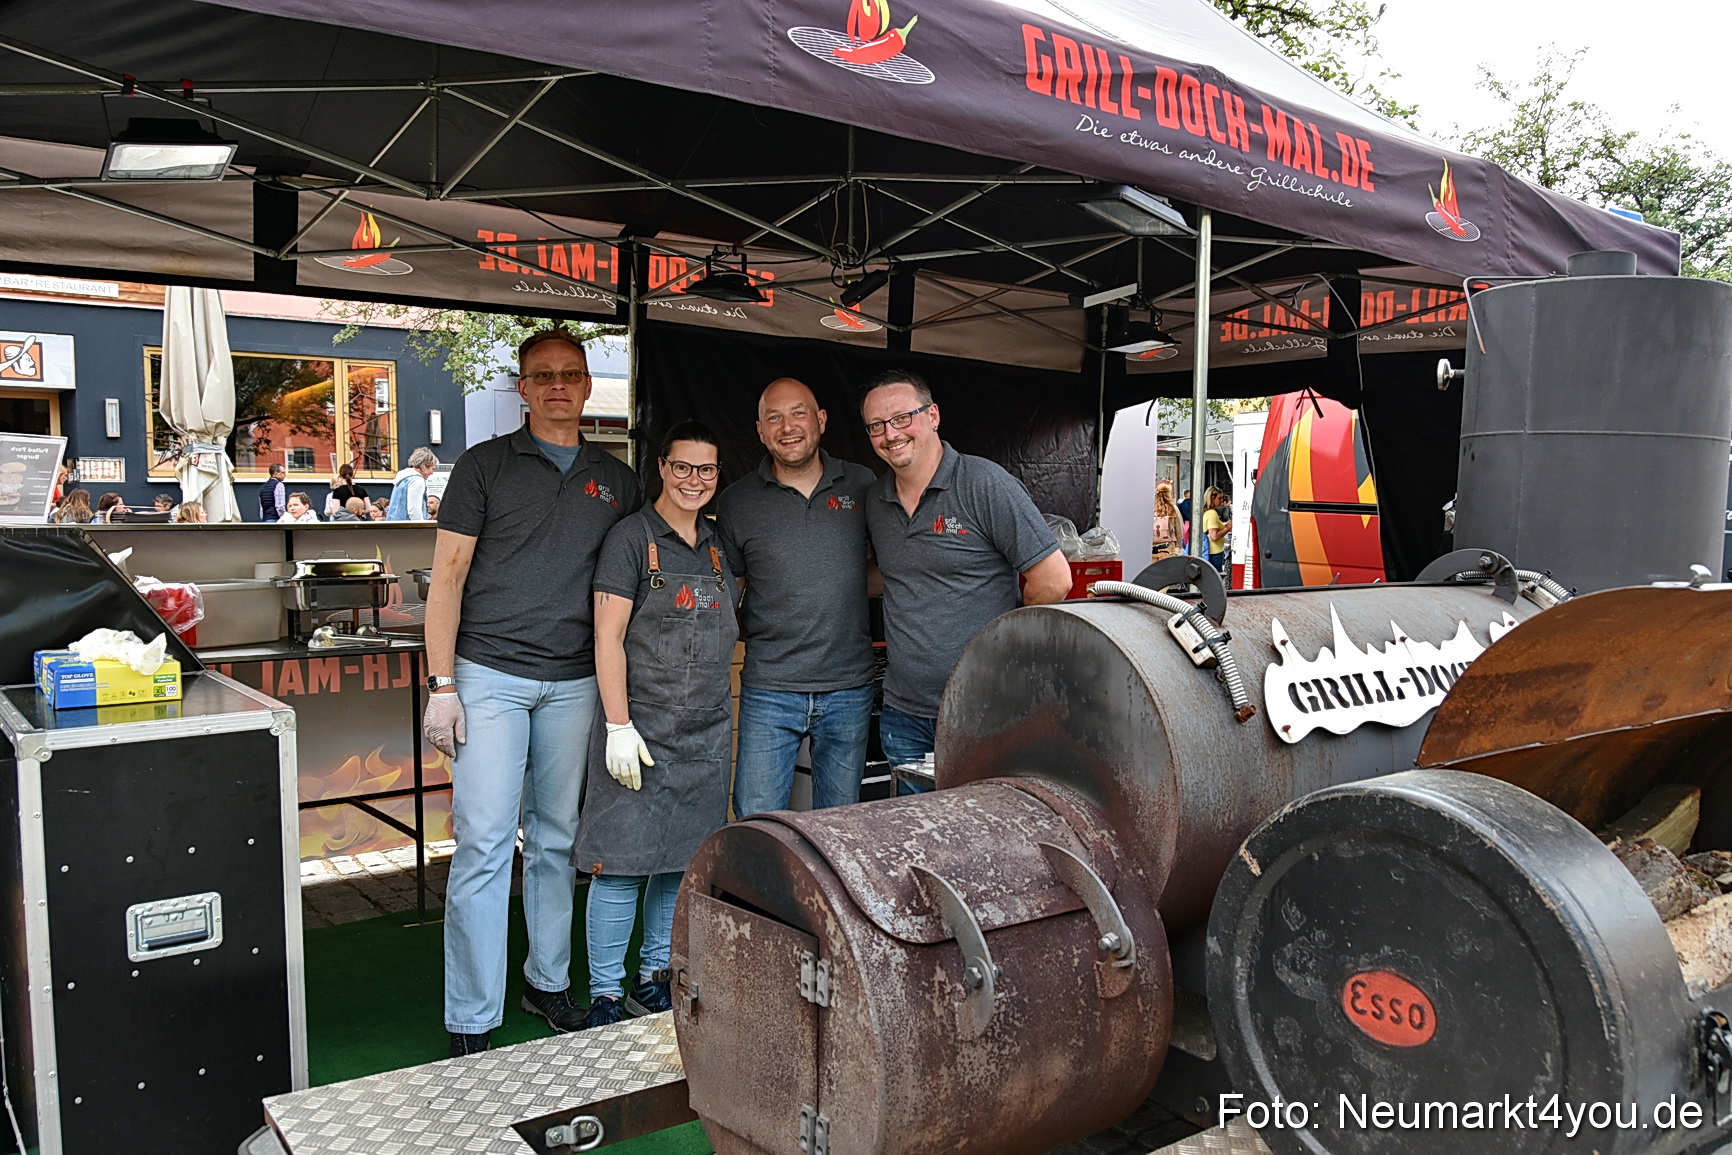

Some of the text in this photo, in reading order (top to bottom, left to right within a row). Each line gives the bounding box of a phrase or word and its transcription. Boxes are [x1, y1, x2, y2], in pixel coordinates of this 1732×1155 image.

[1021, 23, 1376, 193] GRILL-DOCH-MAL.DE
[1075, 114, 1355, 208] Die etwas andere Grillschule
[35, 280, 113, 294] RESTAURANT
[1351, 979, 1425, 1031] ESSO
